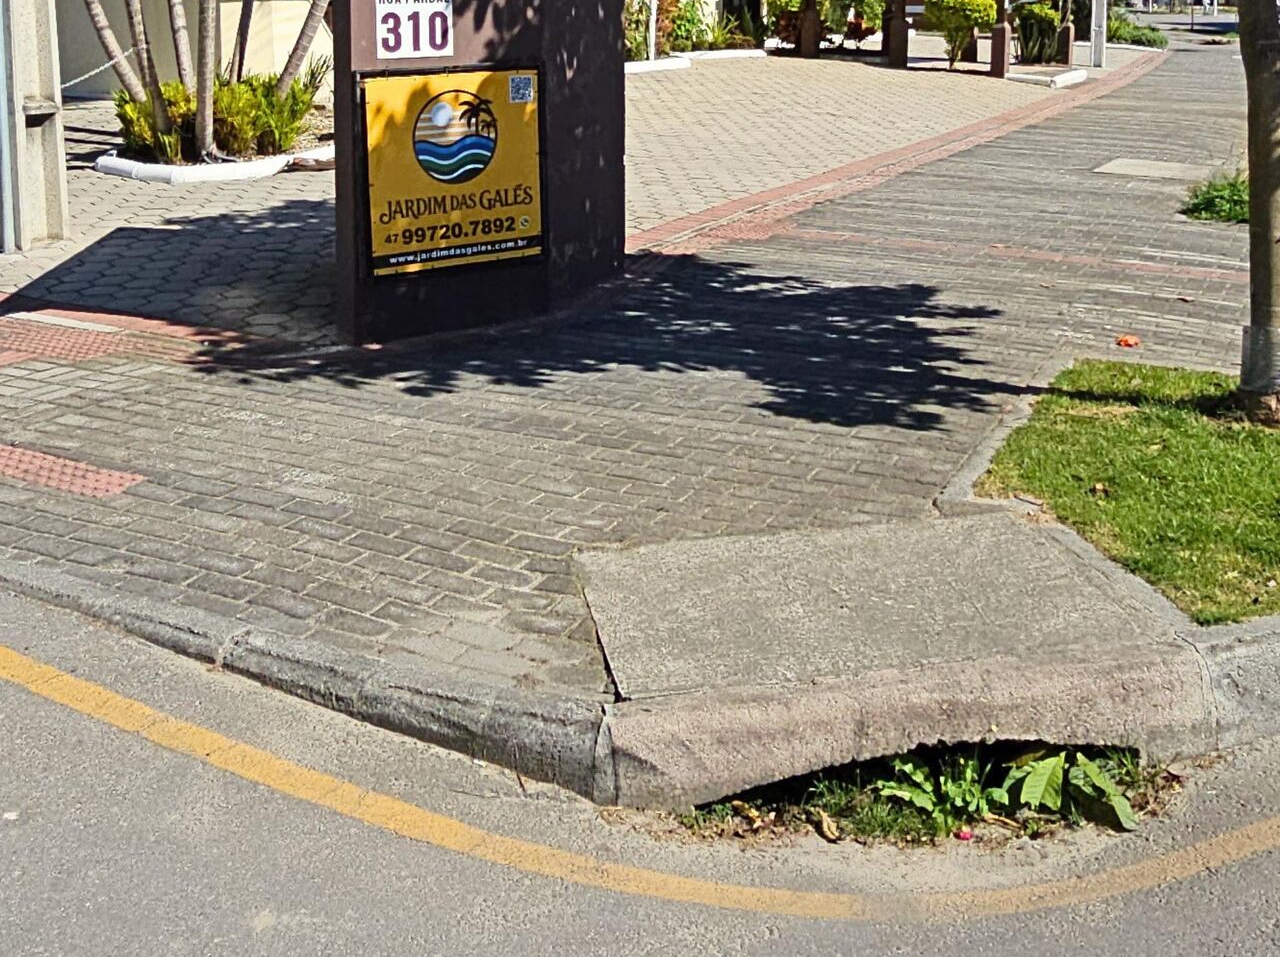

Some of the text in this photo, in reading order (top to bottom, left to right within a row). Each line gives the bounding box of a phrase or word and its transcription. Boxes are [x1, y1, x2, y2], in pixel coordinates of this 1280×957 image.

[381, 11, 449, 53] 310
[379, 183, 533, 225] JARDIM DAS GALÉS
[384, 216, 517, 245] 47 99720.7892
[389, 239, 528, 264] www.jardimdasgales.com.br
